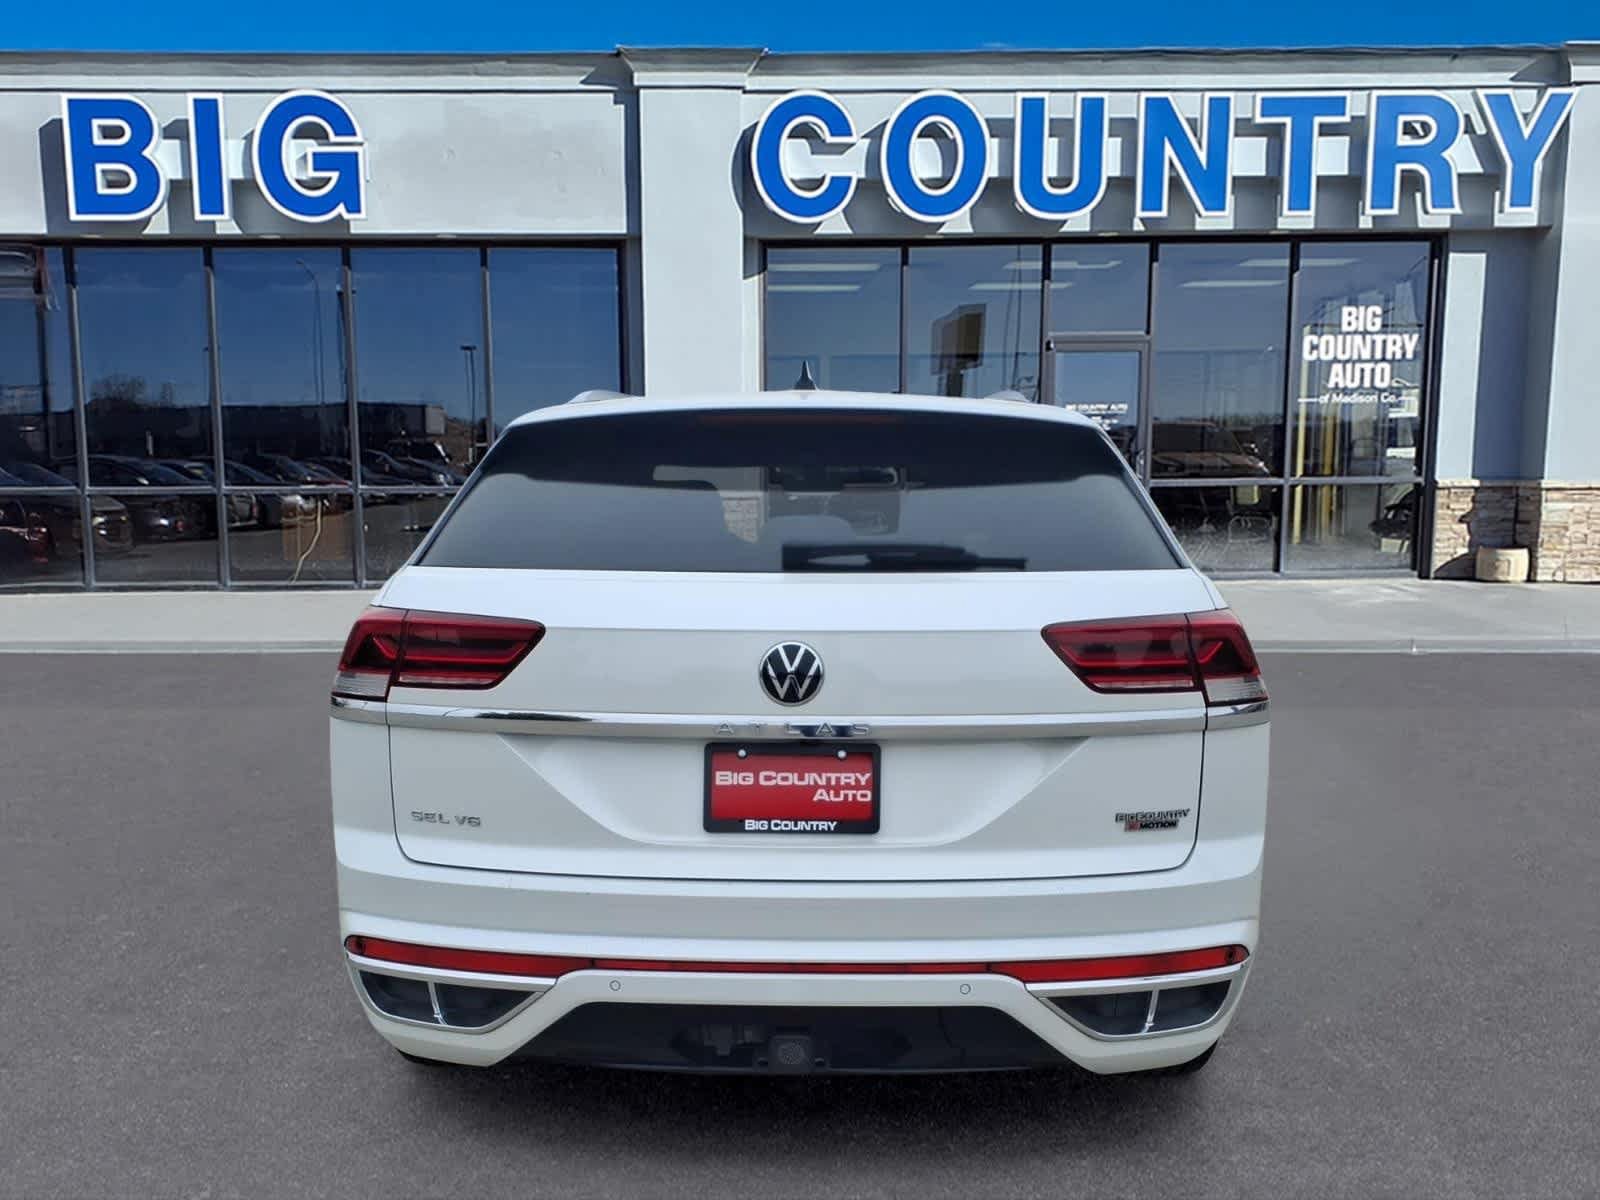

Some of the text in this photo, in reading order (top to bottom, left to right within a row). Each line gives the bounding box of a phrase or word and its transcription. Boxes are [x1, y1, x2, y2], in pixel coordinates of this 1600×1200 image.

[61, 88, 1576, 223] BIG COUNTRY
[1340, 305, 1383, 333] BIG
[1302, 333, 1419, 361] COUNTRY
[1327, 362, 1392, 389] AUTO
[716, 722, 869, 736] ATLAS
[715, 771, 872, 786] BIG COUNTRY
[812, 788, 872, 802] AUTO
[411, 810, 450, 824] SEL
[744, 819, 837, 831] BIG COUNTRY
